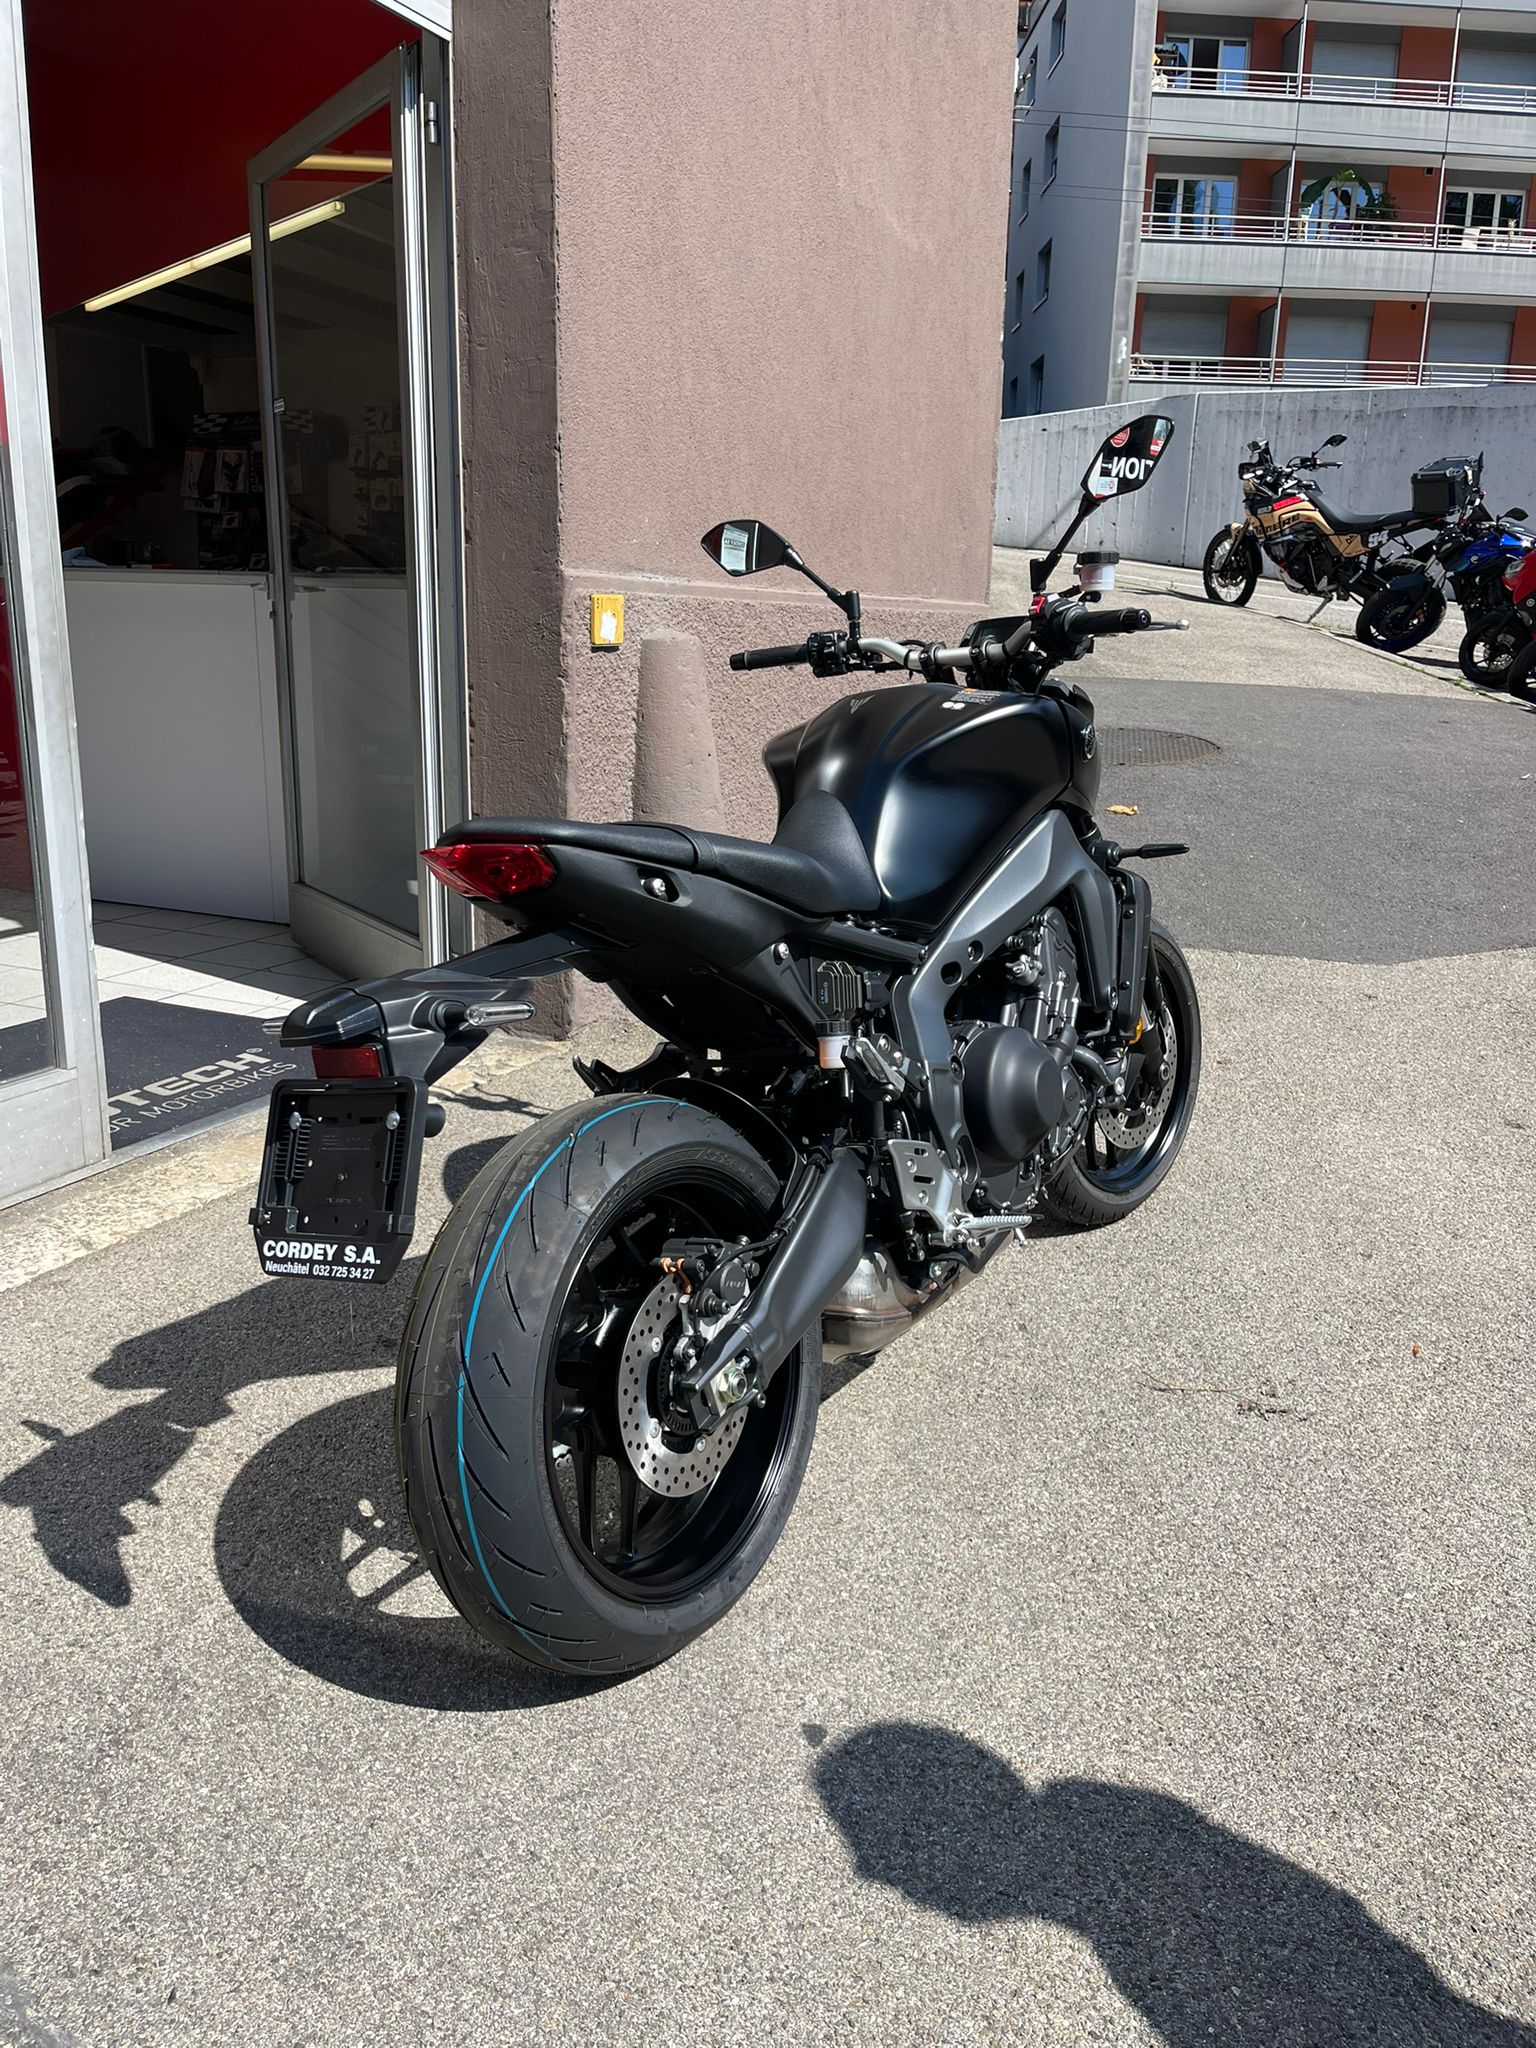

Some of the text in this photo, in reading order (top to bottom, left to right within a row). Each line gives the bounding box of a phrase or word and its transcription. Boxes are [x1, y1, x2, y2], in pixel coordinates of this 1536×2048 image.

[107, 1052, 272, 1117] TECH
[138, 1062, 297, 1118] MOTORBIKES
[263, 1240, 381, 1264] CORDEY S.A.
[265, 1261, 375, 1280] Neuchâtel 032 725 34 27
